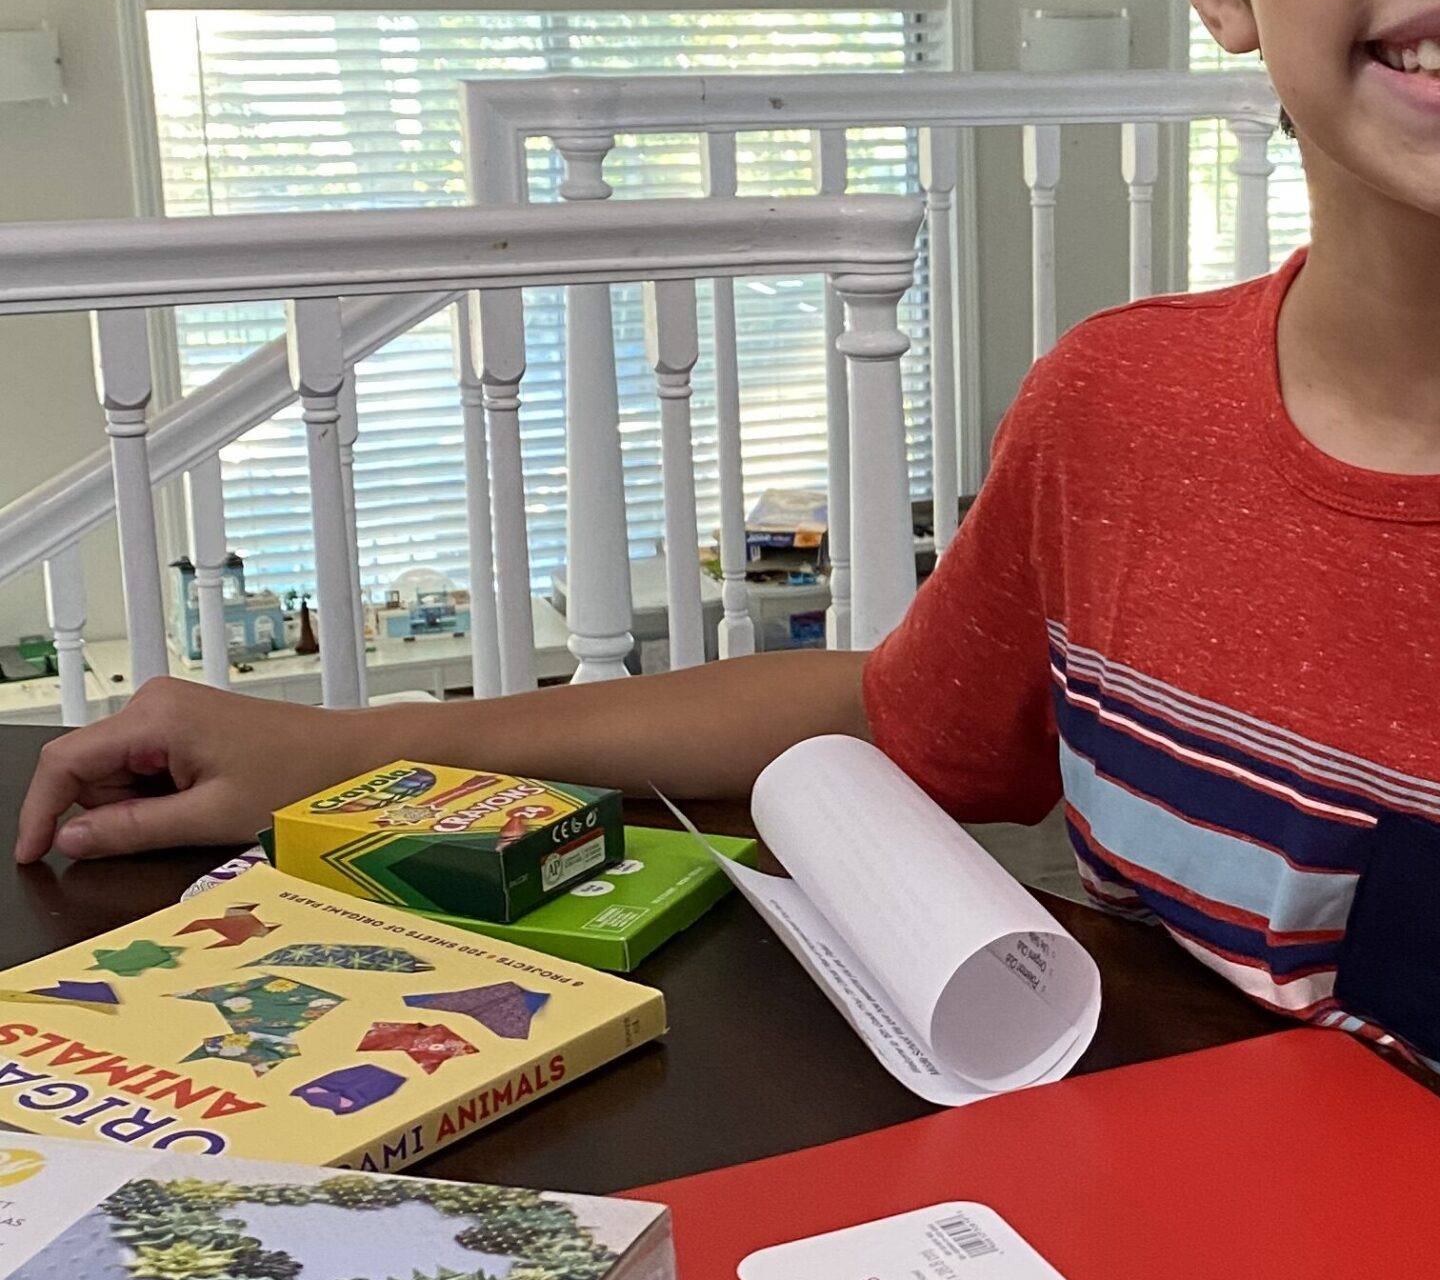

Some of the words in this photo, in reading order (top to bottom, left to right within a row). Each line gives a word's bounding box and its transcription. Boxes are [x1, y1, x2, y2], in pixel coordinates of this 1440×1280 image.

[310, 767, 419, 810] Crayola
[432, 784, 546, 832] CRAYONS
[513, 805, 542, 820] 24
[279, 890, 322, 912] PAPER
[321, 904, 384, 927] ORIGAMI
[383, 923, 405, 936] OF
[405, 929, 459, 949] SHEETS
[496, 957, 569, 987] PROJECTS
[0, 1023, 267, 1120] ANIMALS
[336, 1125, 424, 1173] AMI
[436, 1055, 566, 1142] ANIMALS
